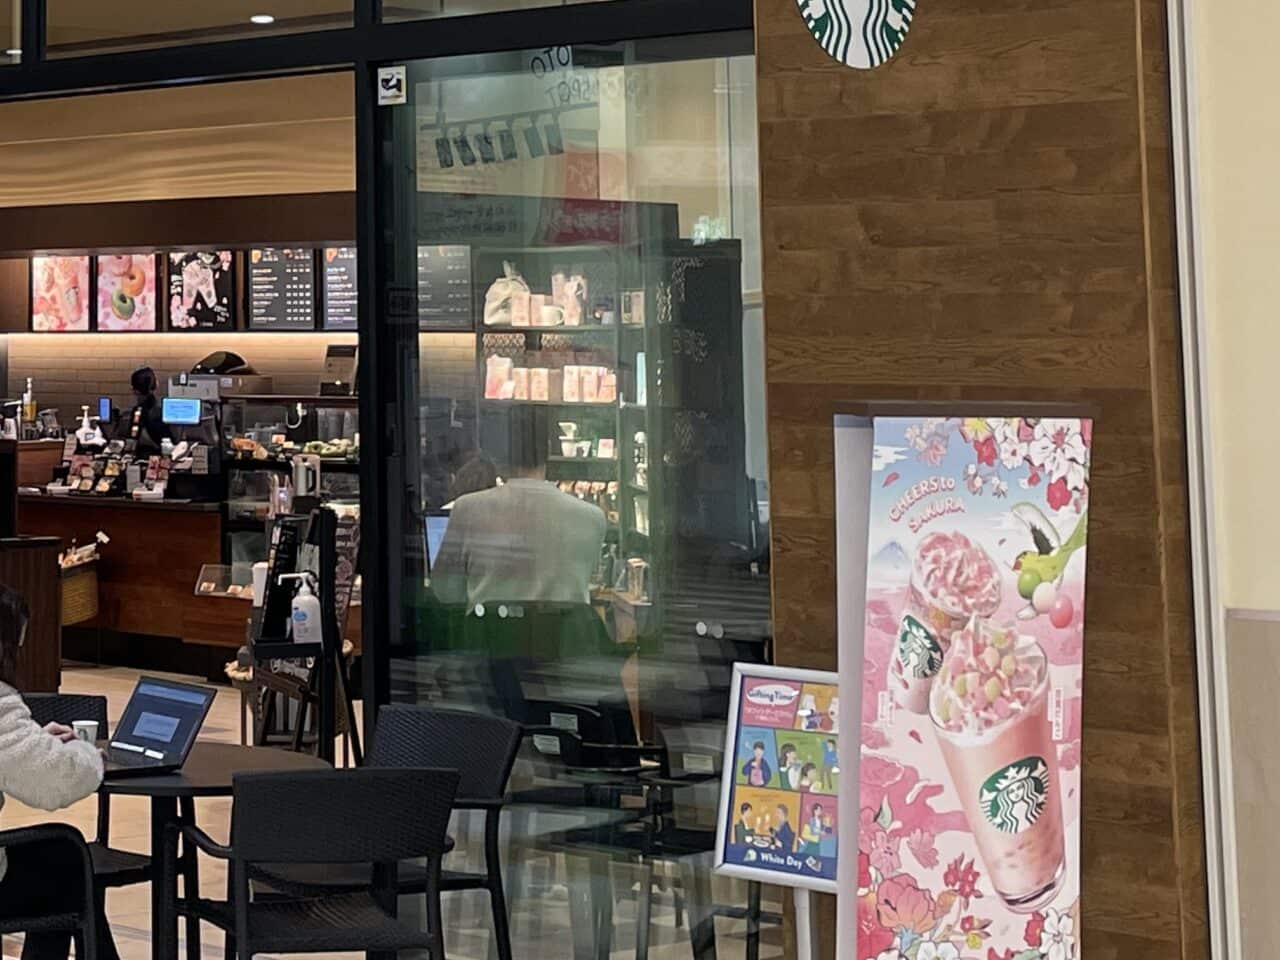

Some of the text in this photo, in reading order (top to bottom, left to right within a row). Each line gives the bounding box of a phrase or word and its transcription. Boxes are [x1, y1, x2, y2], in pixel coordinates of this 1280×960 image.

[889, 477, 939, 522] CHEERS
[908, 497, 966, 534] SAKURA
[760, 852, 803, 870] White Day
